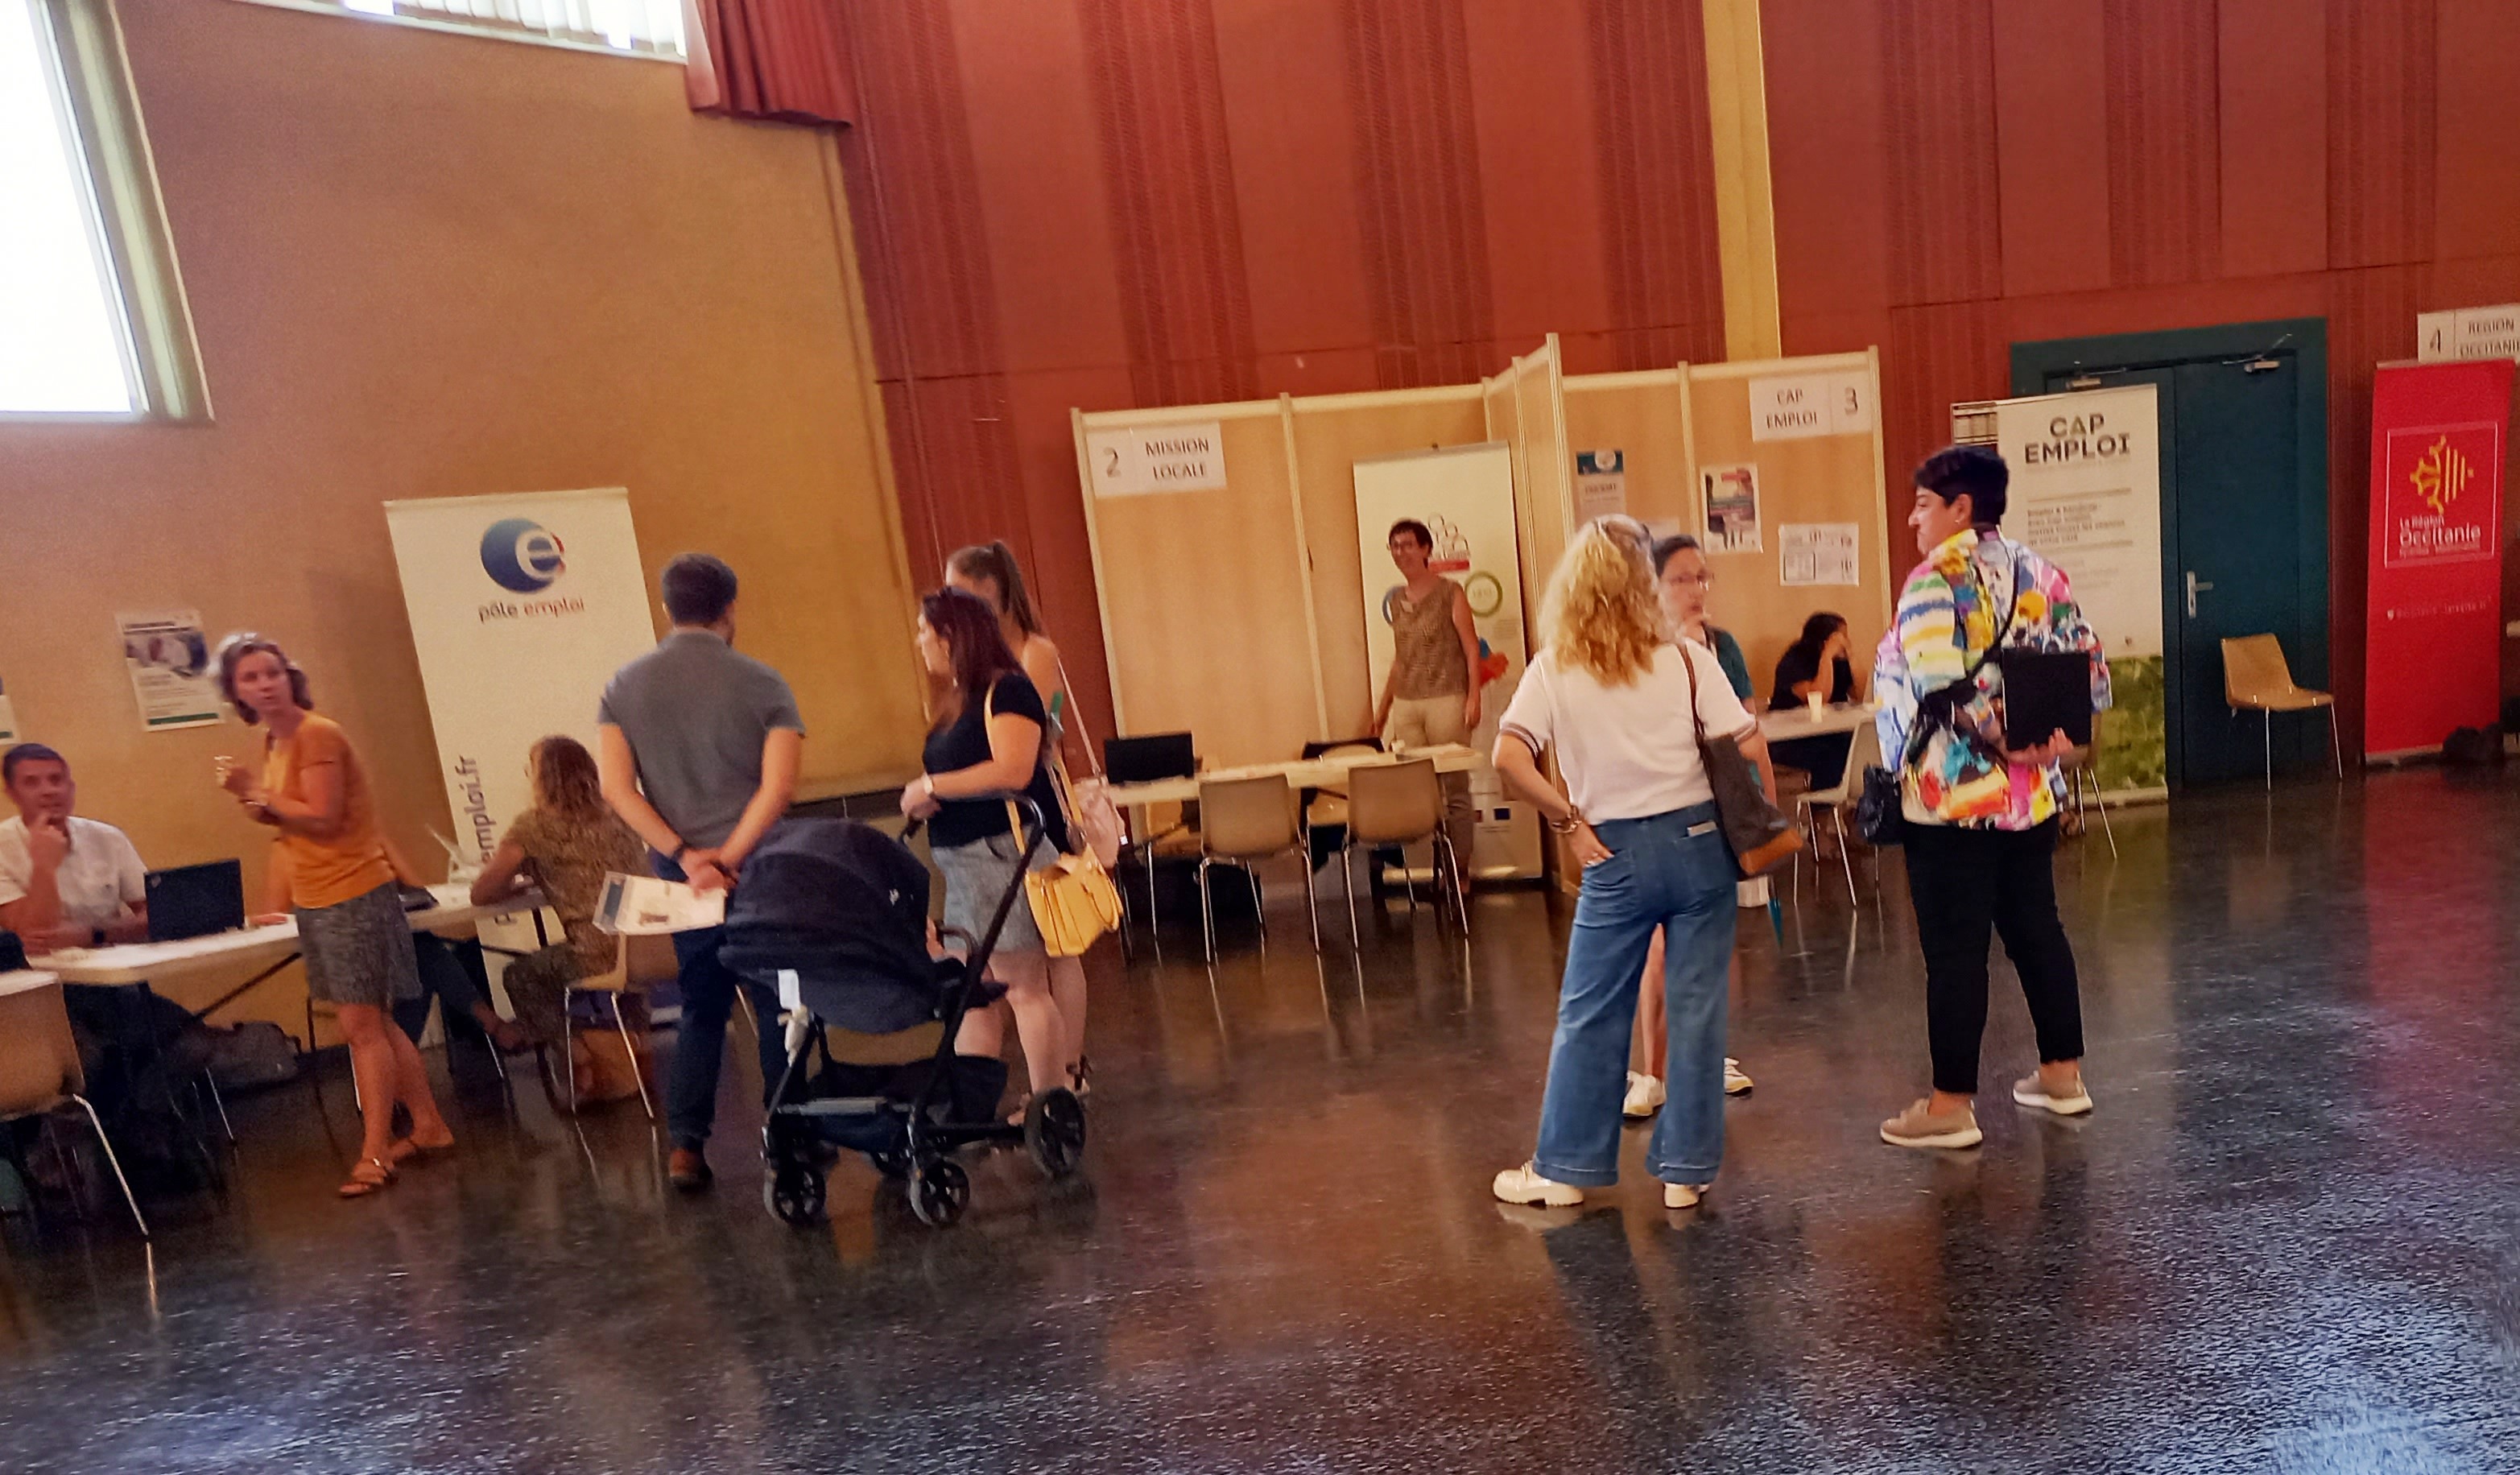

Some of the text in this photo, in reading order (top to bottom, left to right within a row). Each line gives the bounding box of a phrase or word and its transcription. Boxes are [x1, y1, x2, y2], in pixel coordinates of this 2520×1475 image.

[1777, 388, 1803, 404] CAP
[1845, 386, 1858, 415] 3
[1766, 411, 1817, 429] EMPLOI
[2050, 412, 2105, 438] CAP
[1145, 437, 1209, 457] MISSION
[2024, 432, 2130, 465] EMPLOI
[1103, 446, 1122, 477] 2
[1152, 461, 1205, 481] LOCALE
[524, 596, 585, 618] emploi
